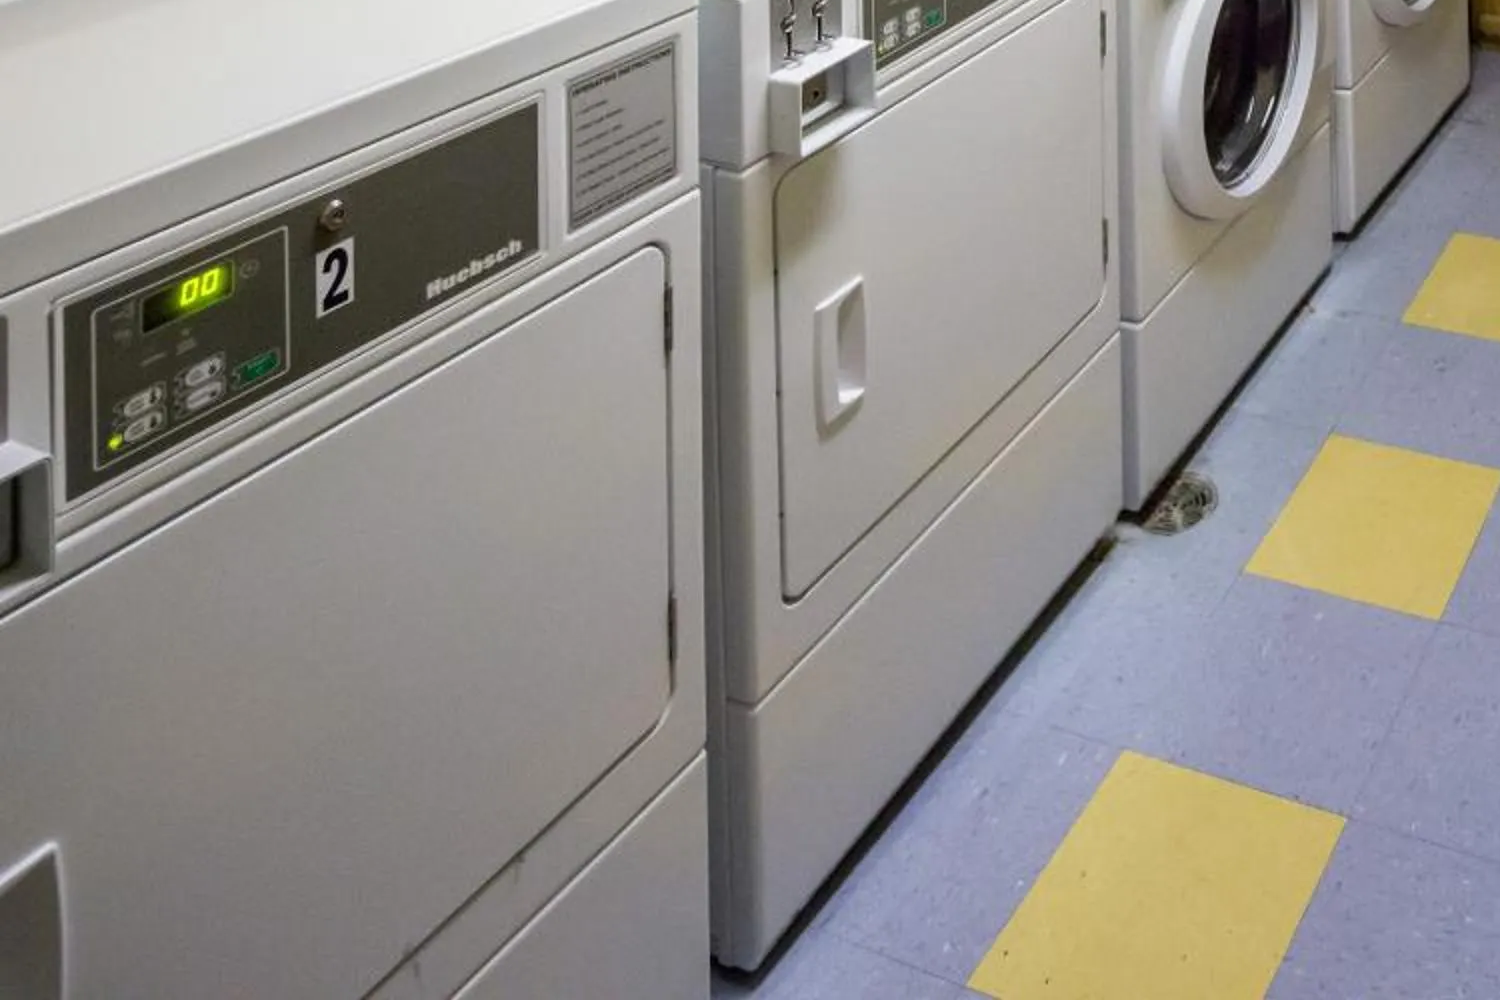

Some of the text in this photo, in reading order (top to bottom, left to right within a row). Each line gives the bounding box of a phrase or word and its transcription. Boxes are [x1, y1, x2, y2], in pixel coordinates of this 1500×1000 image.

[180, 267, 220, 307] 00
[322, 247, 349, 313] 2
[426, 239, 523, 300] Huebsch
